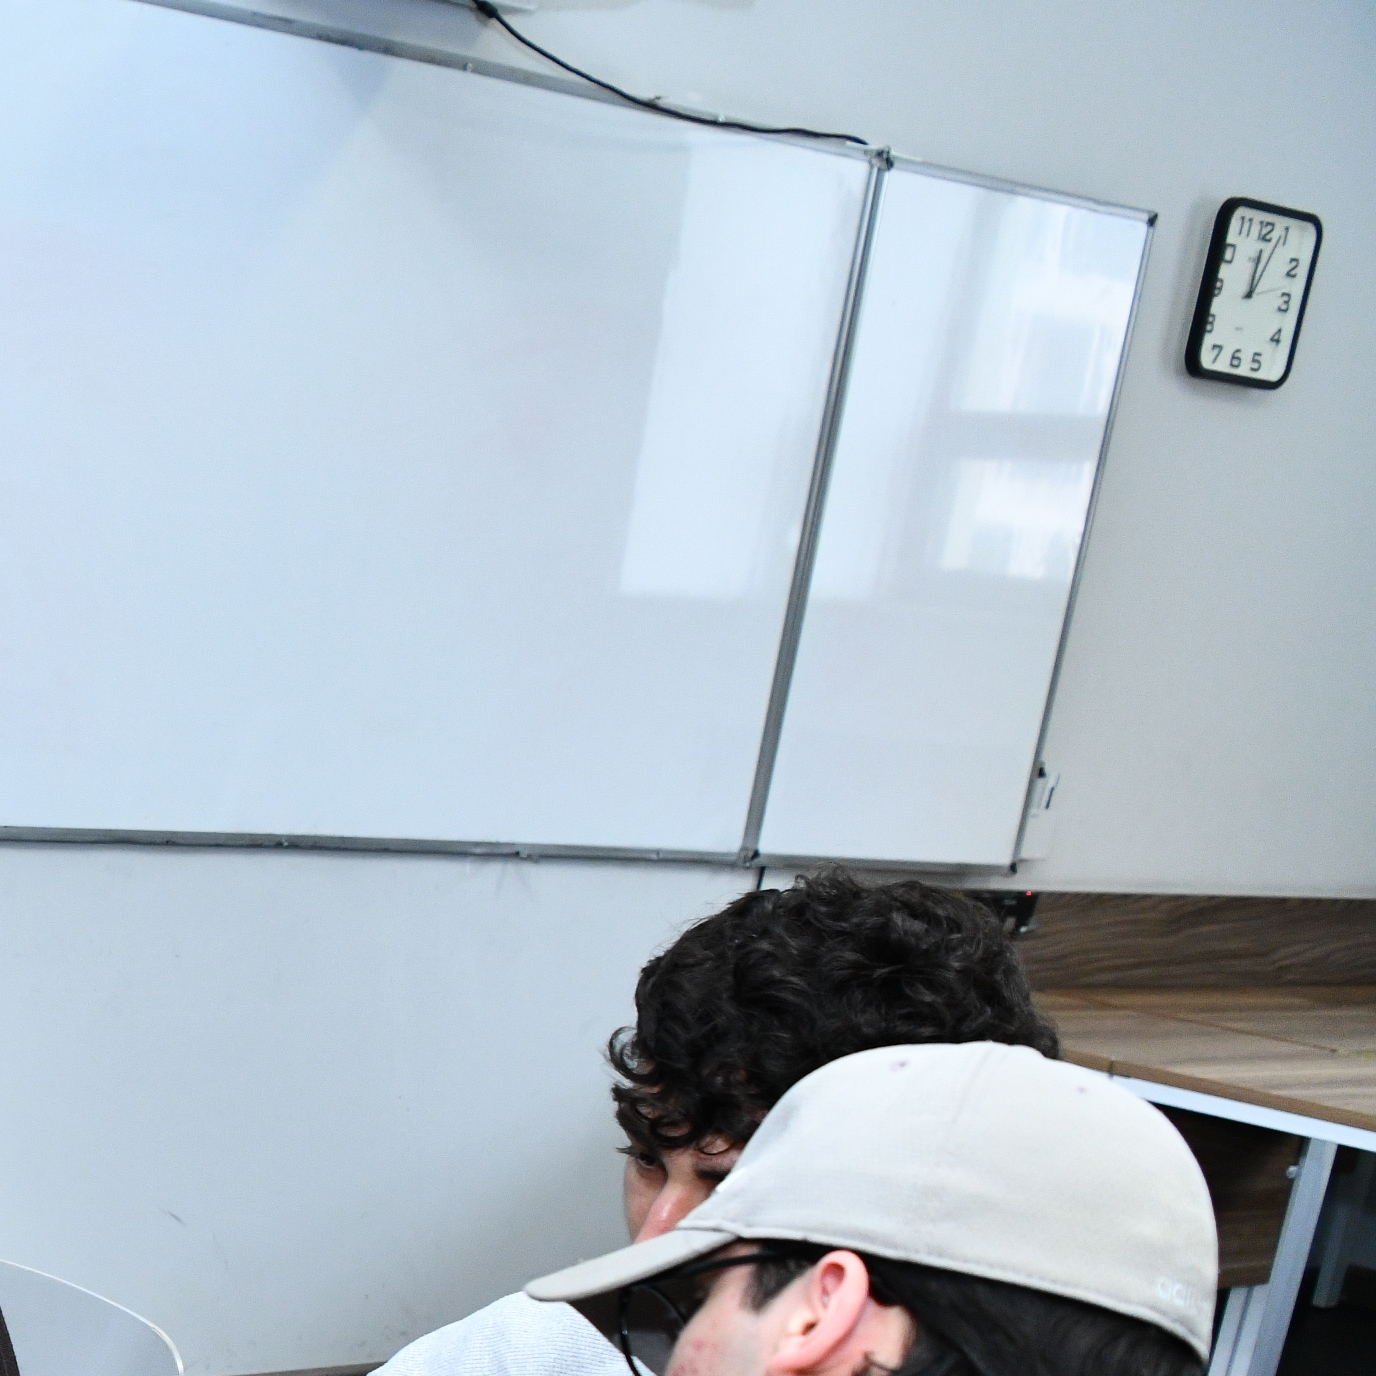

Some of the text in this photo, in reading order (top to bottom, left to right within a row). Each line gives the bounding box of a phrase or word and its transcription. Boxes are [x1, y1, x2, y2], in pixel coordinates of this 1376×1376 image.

[1238, 215, 1291, 247] 11 12 1
[1285, 257, 1300, 278] 2
[1277, 291, 1292, 313] 3
[1269, 327, 1283, 347] 4
[1211, 344, 1263, 372] 7 6 5
